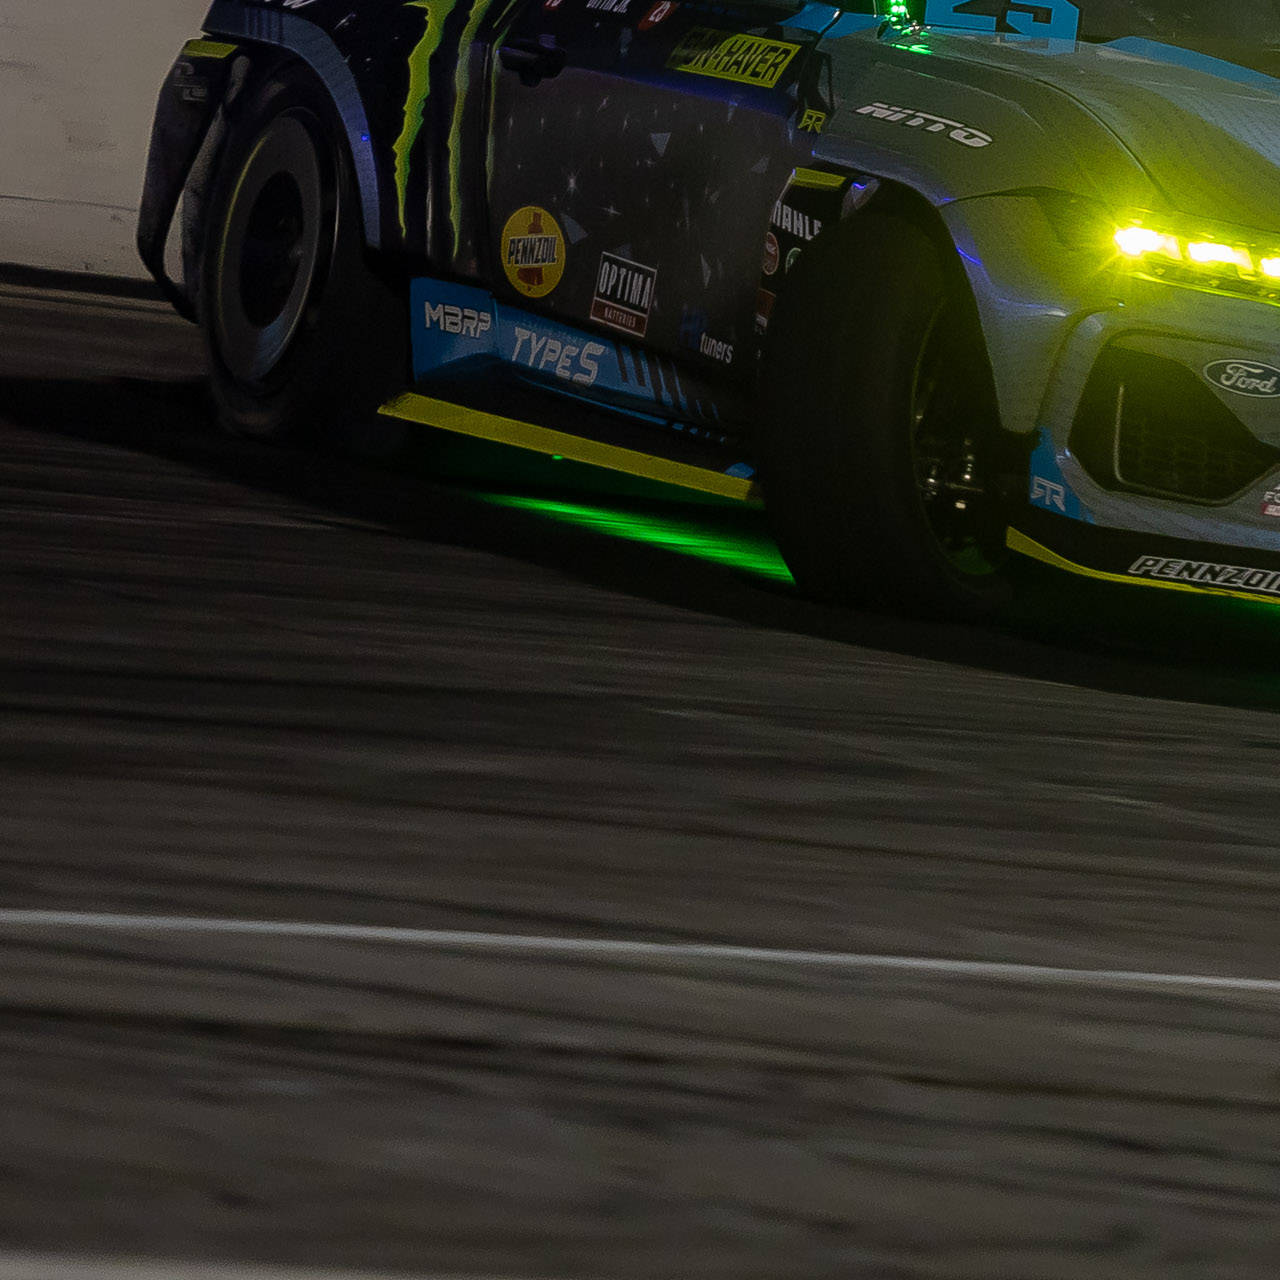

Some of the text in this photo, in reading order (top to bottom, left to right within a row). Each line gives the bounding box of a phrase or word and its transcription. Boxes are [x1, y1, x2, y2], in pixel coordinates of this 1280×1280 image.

[855, 102, 993, 148] NITTO
[507, 236, 558, 264] PENNZOIL
[599, 261, 652, 309] OPTIMA
[424, 301, 491, 338] MBRP
[700, 331, 734, 365] tuners
[1220, 363, 1279, 393] Ford
